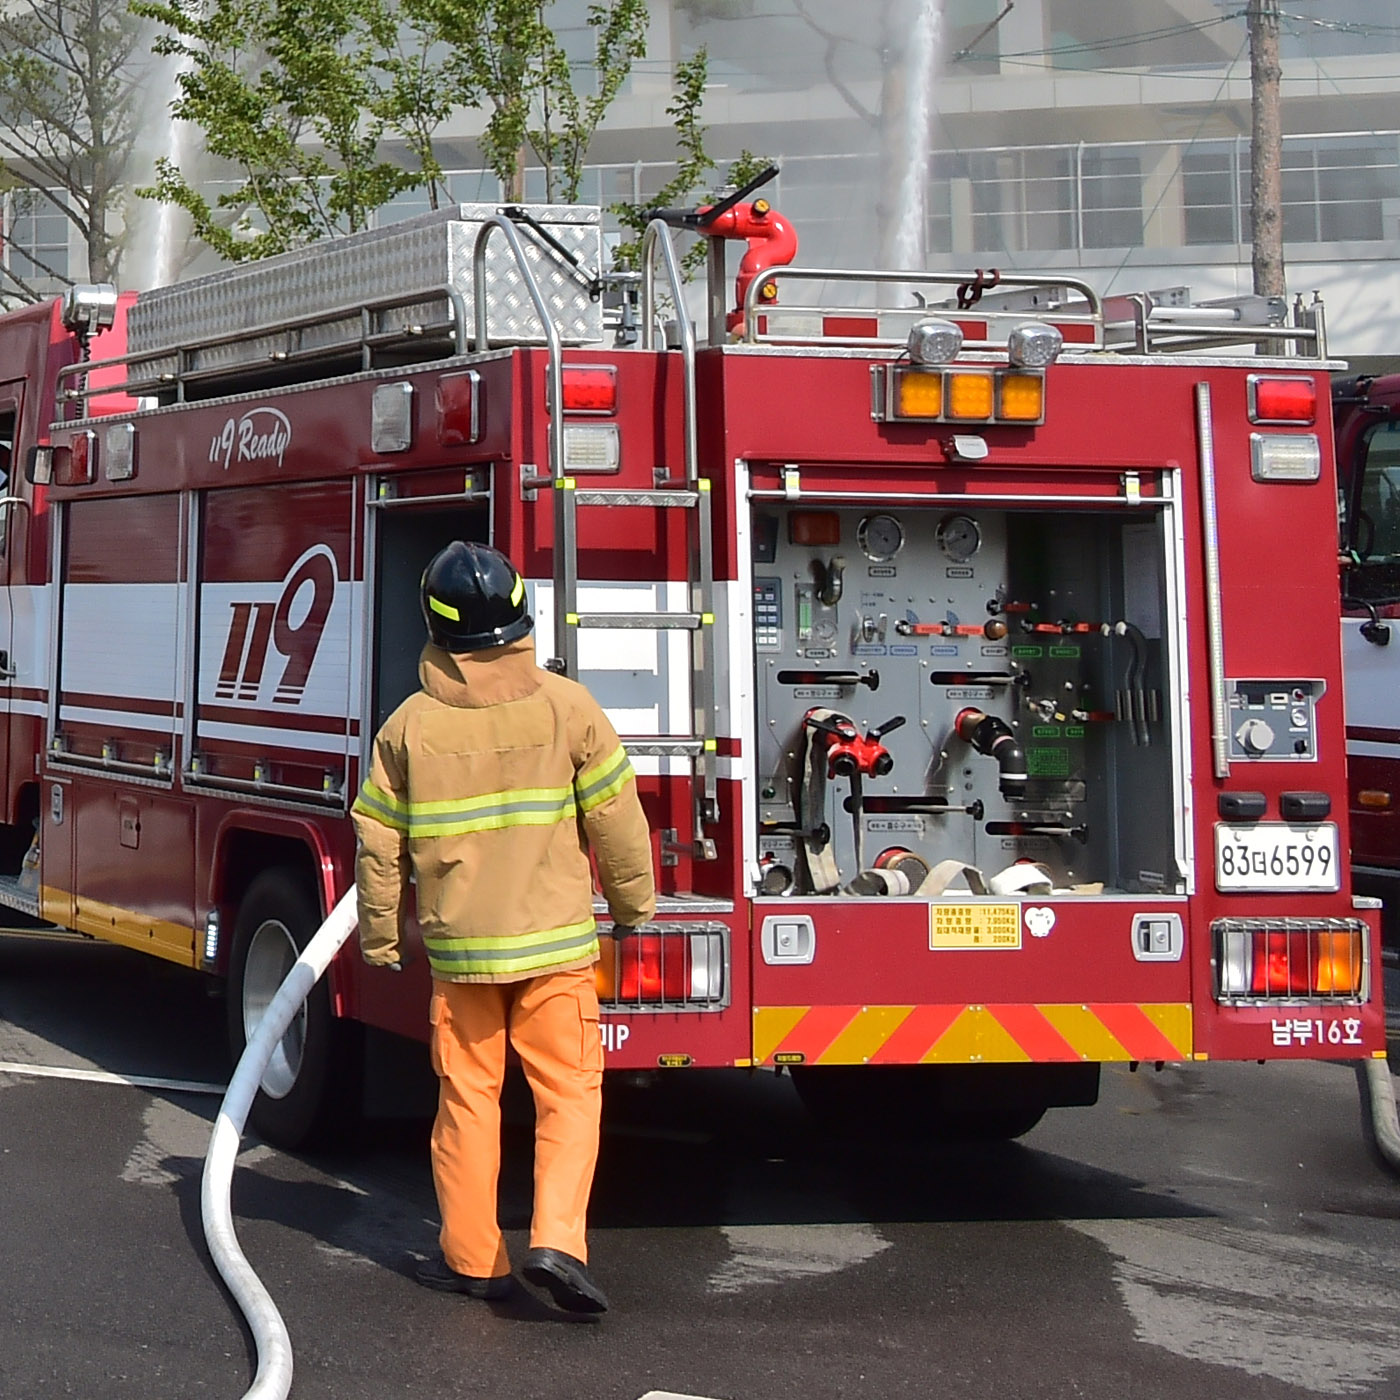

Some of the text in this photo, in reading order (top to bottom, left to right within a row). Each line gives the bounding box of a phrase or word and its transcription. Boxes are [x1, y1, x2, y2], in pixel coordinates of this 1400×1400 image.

[208, 418, 287, 470] 119 Ready
[213, 543, 339, 706] 119
[1221, 844, 1332, 877] 83더6599
[1272, 1017, 1363, 1047] 남부16호
